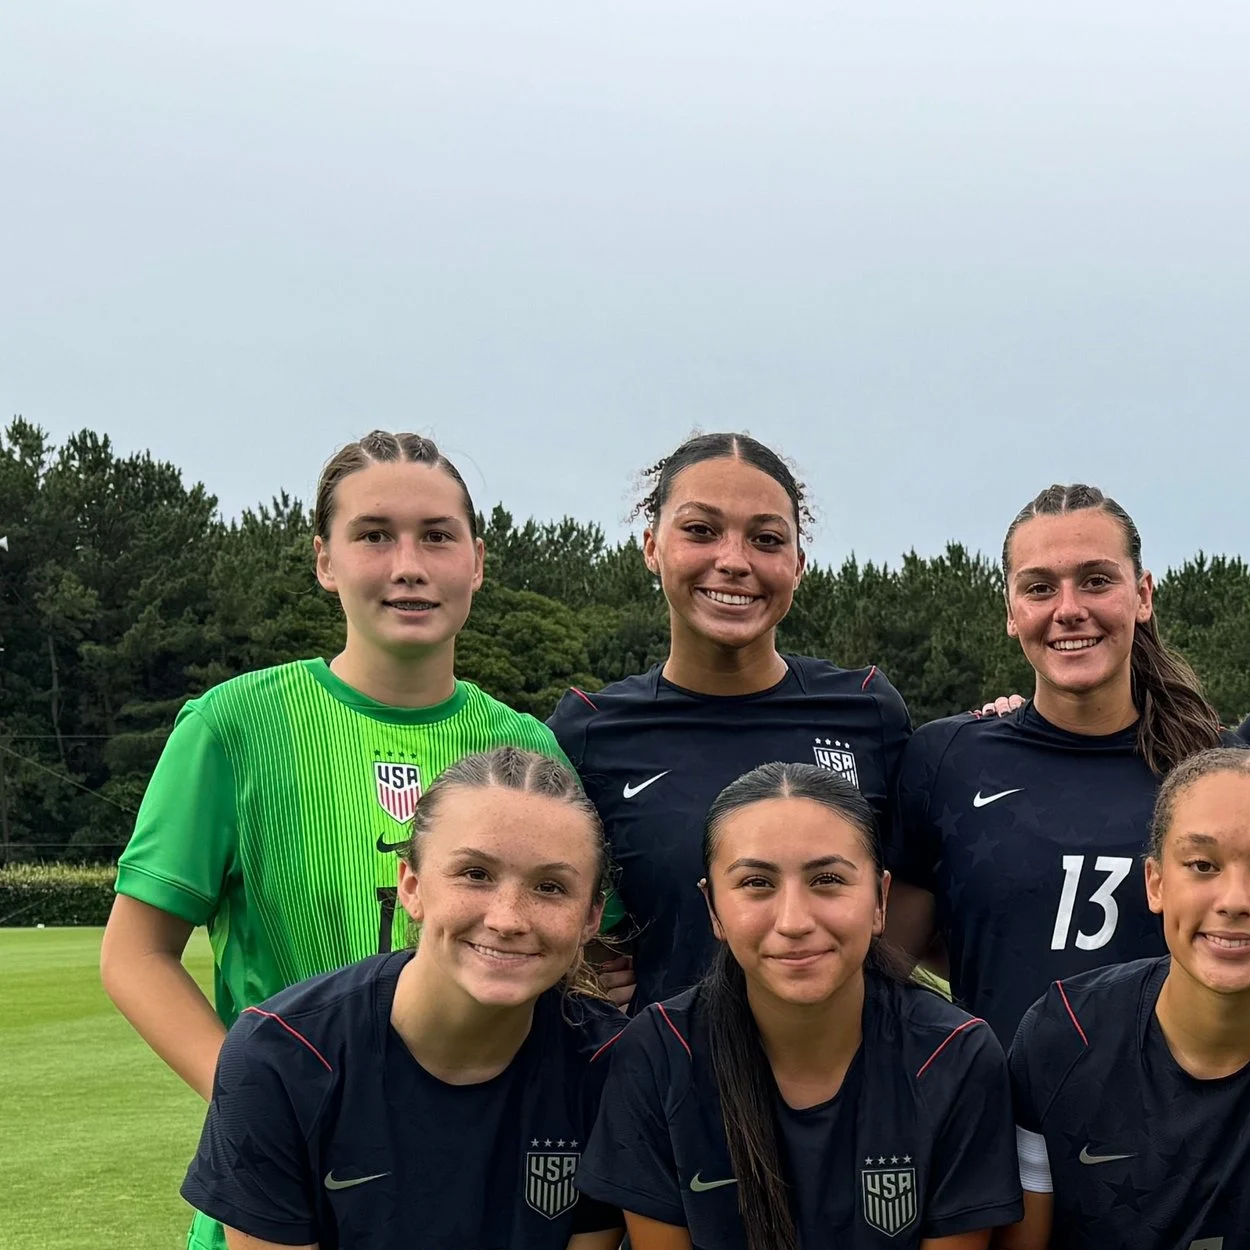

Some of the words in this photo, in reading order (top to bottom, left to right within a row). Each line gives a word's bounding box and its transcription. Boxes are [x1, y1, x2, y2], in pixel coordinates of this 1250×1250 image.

[817, 750, 853, 772] USA
[377, 765, 418, 789] USA
[1050, 855, 1133, 951] 13
[531, 1156, 577, 1182] USA
[866, 1172, 912, 1199] USA
